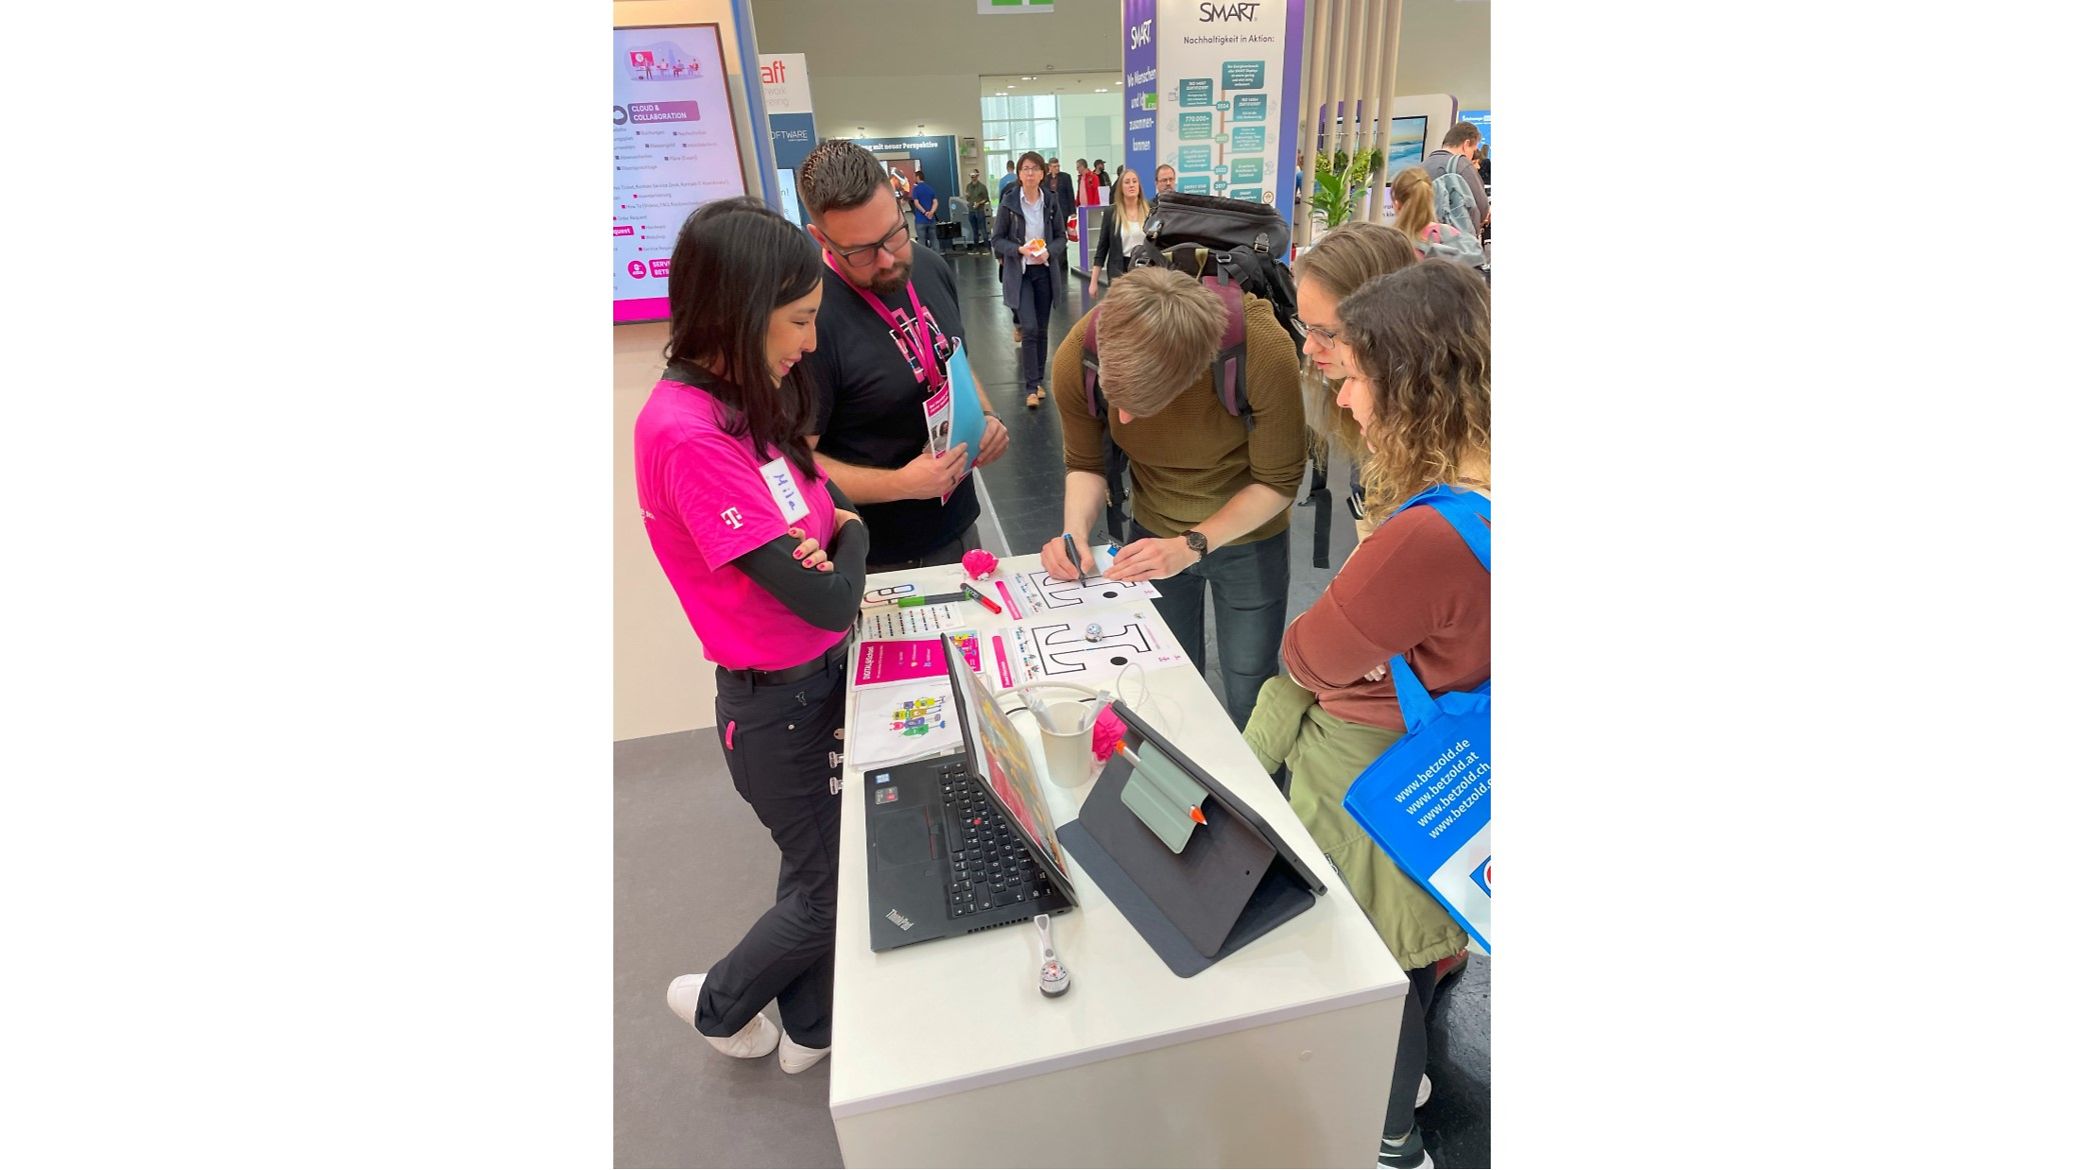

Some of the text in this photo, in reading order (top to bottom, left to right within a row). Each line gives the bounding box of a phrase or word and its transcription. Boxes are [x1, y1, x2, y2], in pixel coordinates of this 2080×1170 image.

[1199, 3, 1260, 22] SMART
[1131, 19, 1152, 50] SMART
[1184, 36, 1238, 45] Nachhaltigkeit
[633, 112, 687, 121] COLLABORATION
[902, 141, 938, 150] Perspektive
[773, 474, 796, 511] Mila
[720, 507, 744, 530] T
[1394, 738, 1470, 803] www.betzold.de
[1406, 751, 1480, 815] www.betzold.at
[1417, 762, 1491, 828] www.betzold.ch
[885, 908, 915, 931] ThinkPad
